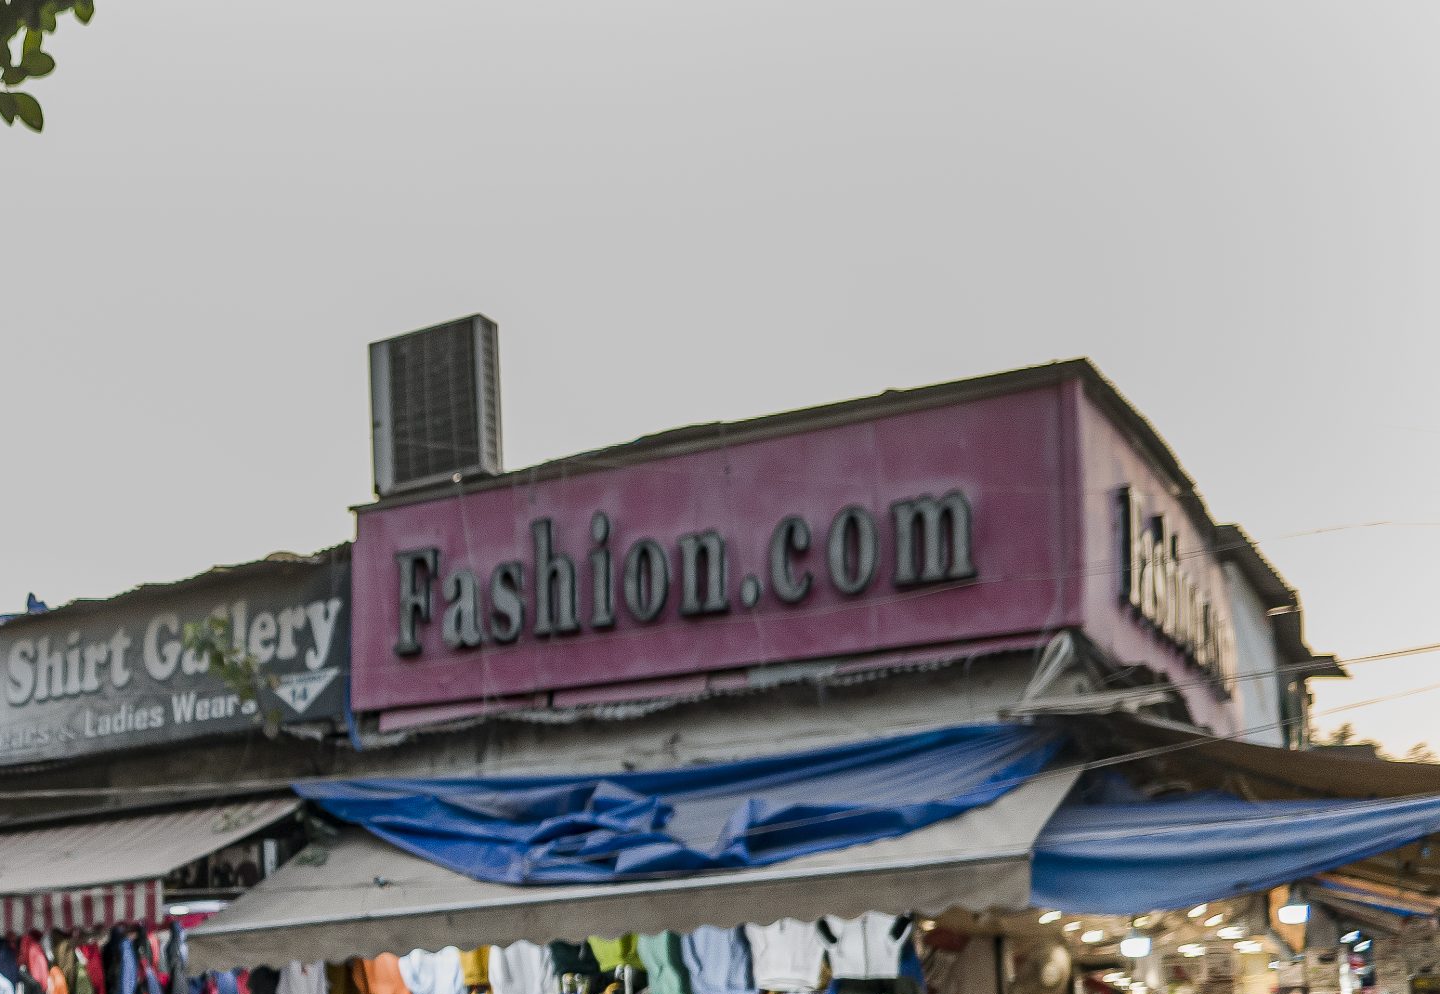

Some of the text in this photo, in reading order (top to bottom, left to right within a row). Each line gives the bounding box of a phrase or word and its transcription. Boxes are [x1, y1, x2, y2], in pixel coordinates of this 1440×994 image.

[393, 488, 978, 657] Fashion.com
[9, 627, 133, 706] Shirt
[84, 704, 165, 738] Ladies
